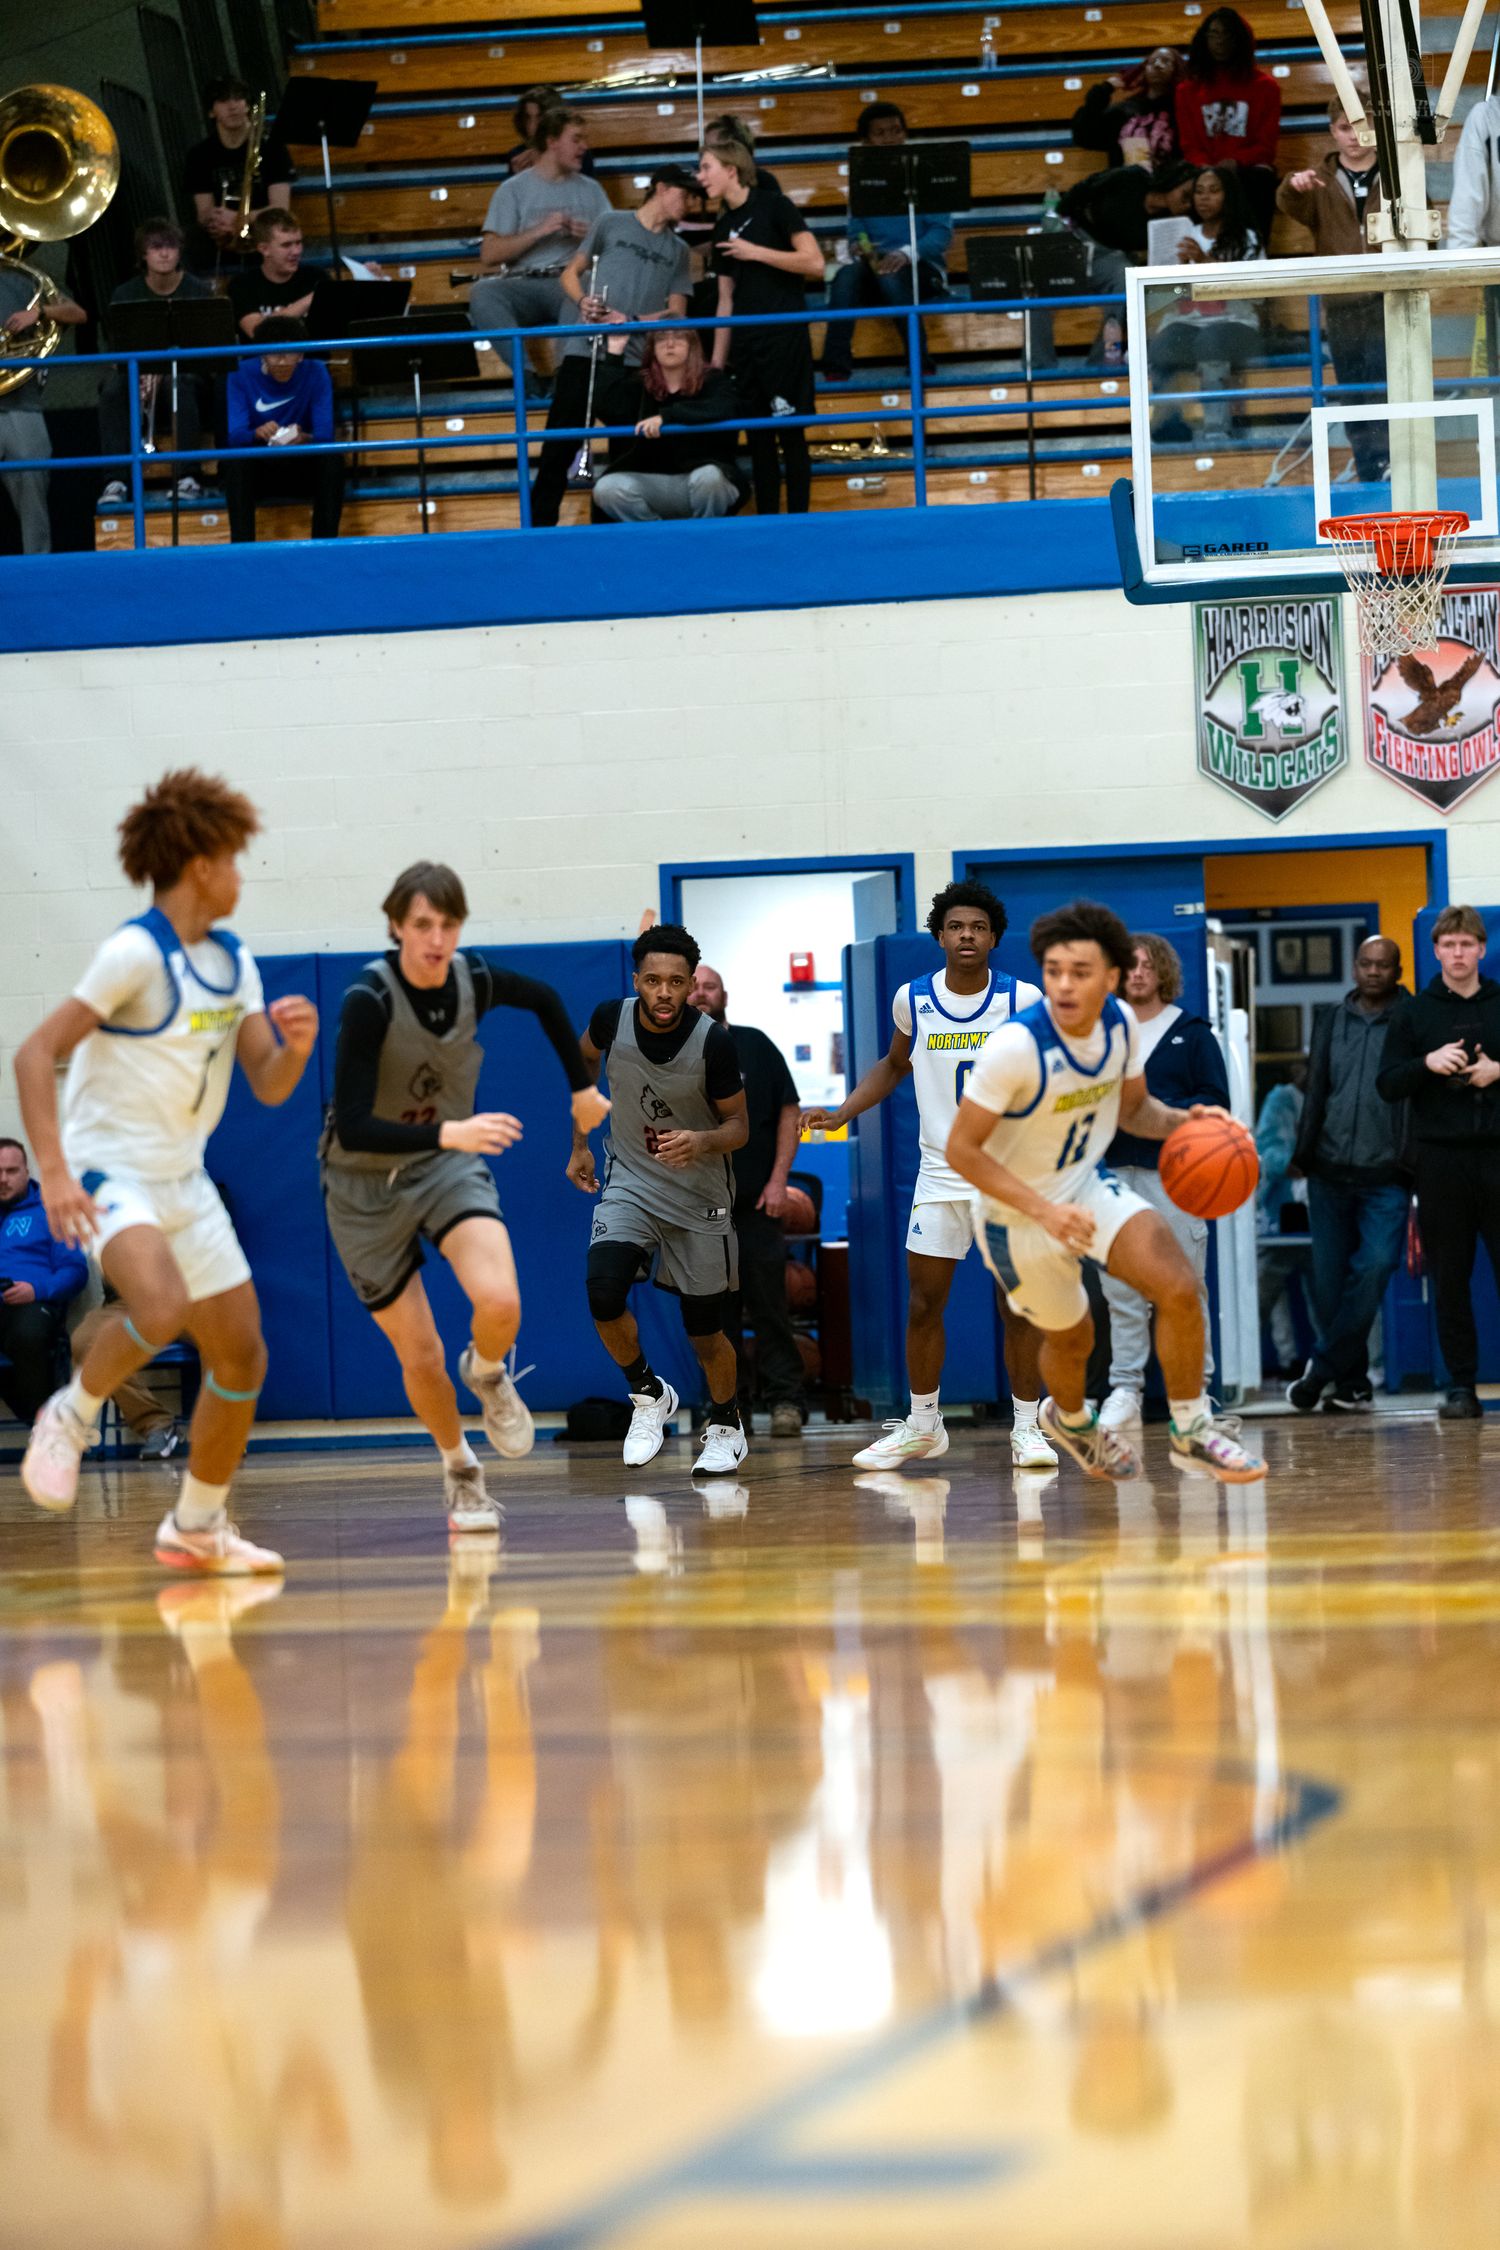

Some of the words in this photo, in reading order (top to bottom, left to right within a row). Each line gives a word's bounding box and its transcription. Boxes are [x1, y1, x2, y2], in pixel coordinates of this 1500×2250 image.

[1204, 542, 1269, 553] GARED
[1202, 601, 1337, 700] HARRISON
[1204, 709, 1339, 790] WILDCATS
[1373, 708, 1461, 781] FIGHTING
[927, 1031, 992, 1051] NORTHWE
[643, 1125, 673, 1155] 2
[1056, 1111, 1096, 1171] 12
